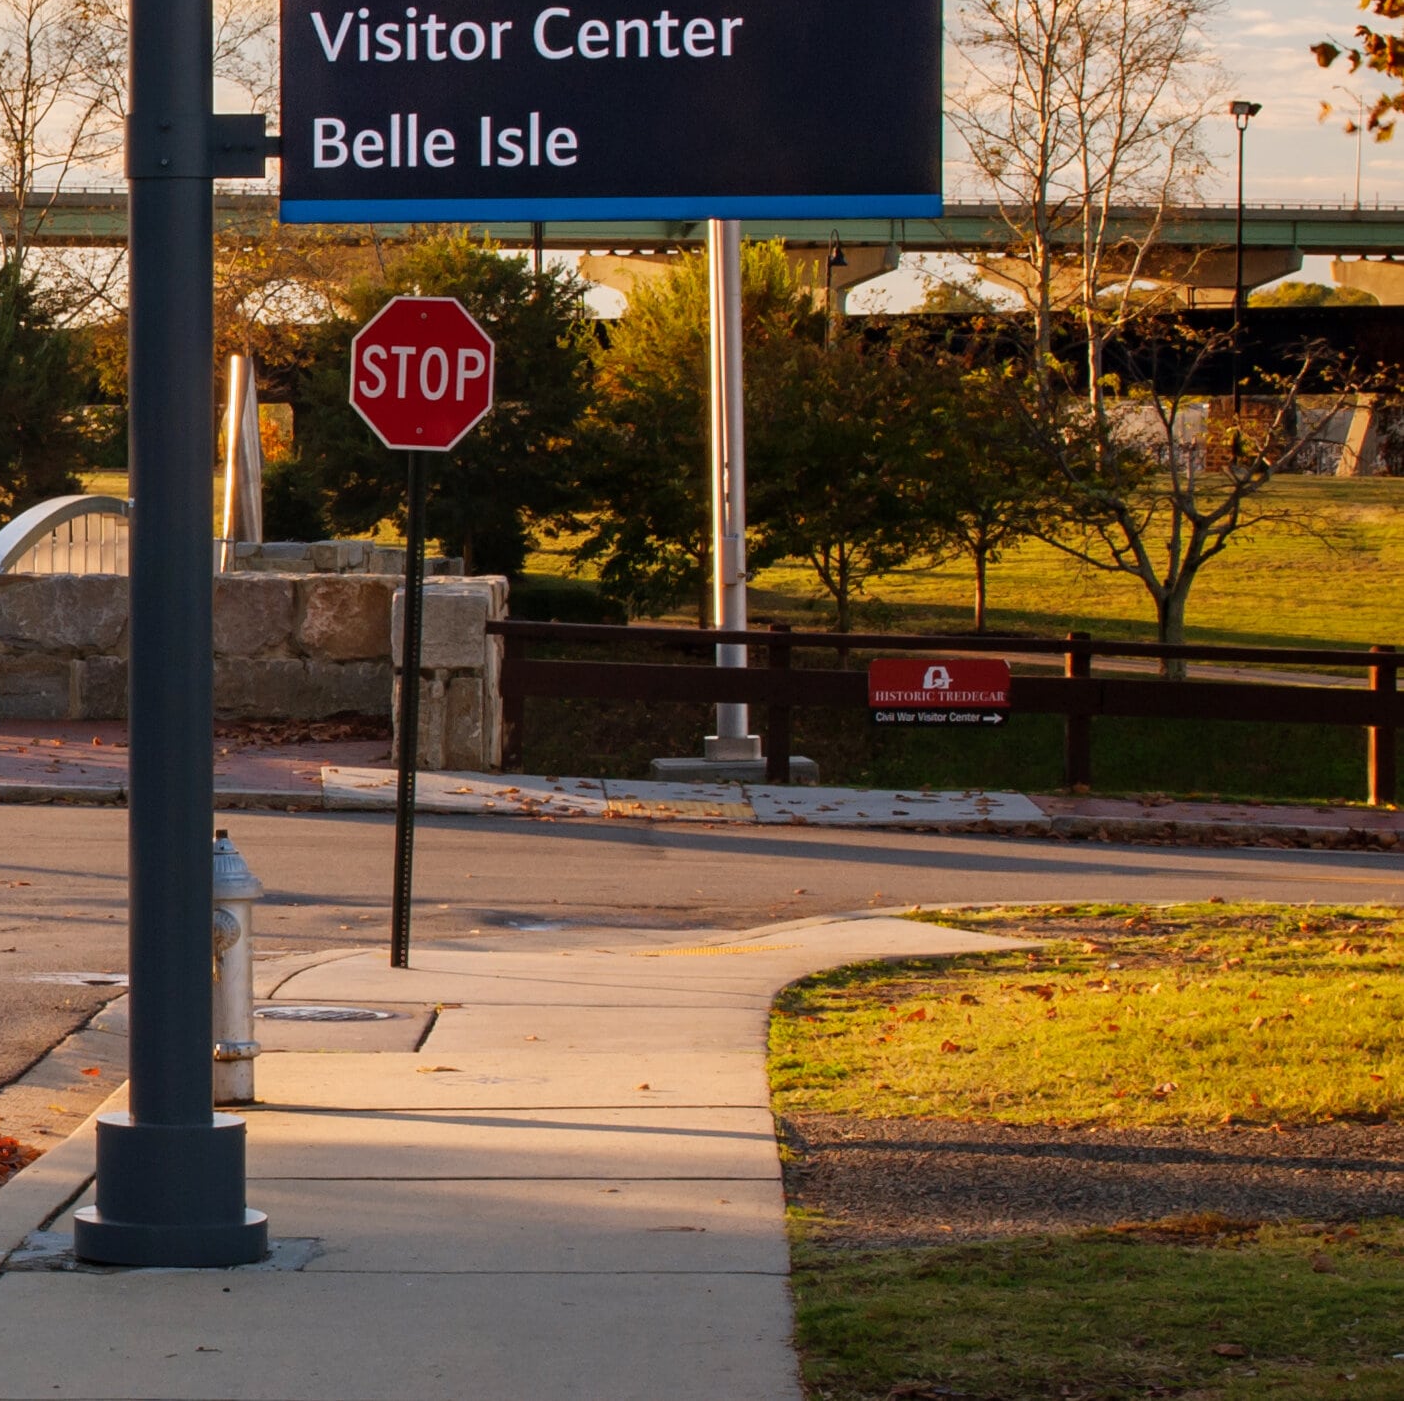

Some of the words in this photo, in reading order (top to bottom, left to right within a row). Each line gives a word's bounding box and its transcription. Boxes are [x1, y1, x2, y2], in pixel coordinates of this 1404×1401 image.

[311, 7, 512, 61] Visitor
[534, 8, 743, 59] Center
[315, 114, 455, 167] Belle
[482, 112, 577, 166] Isle
[359, 344, 486, 402] STOP
[875, 690, 936, 701] HISTORIC
[938, 691, 1005, 702] TREDEGAR
[876, 712, 895, 721] Civil
[897, 713, 915, 721] War
[918, 712, 947, 722] Visitor
[949, 712, 980, 722] Center
